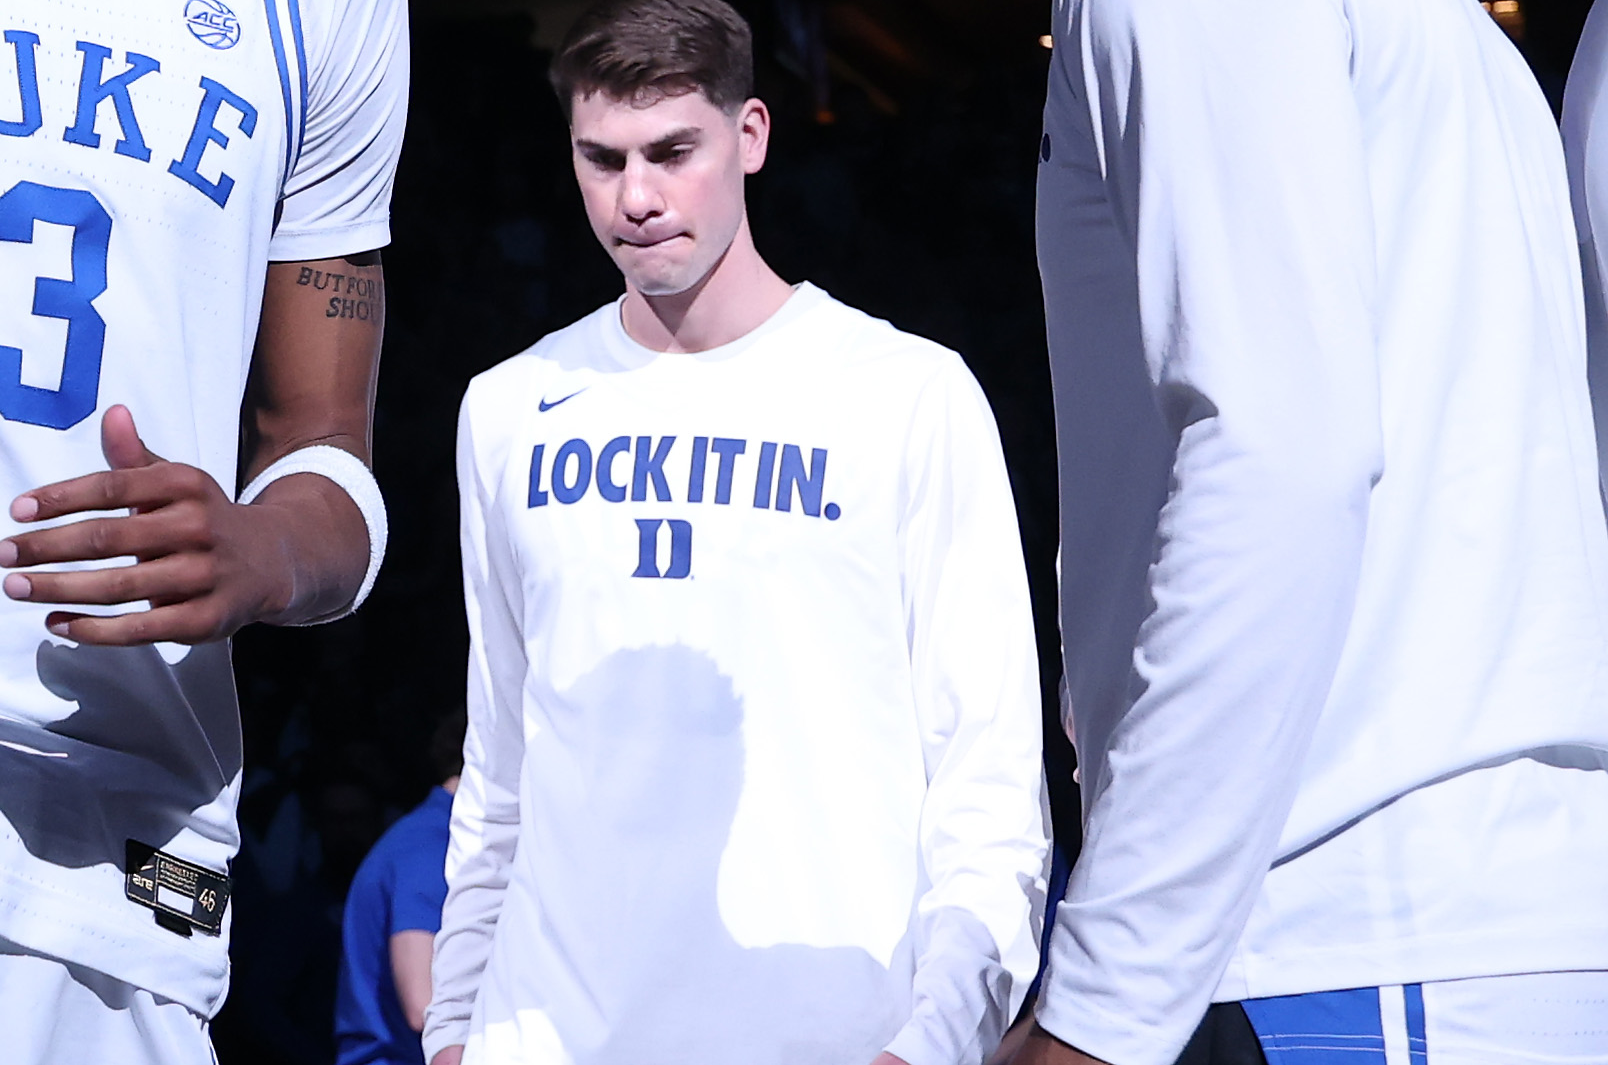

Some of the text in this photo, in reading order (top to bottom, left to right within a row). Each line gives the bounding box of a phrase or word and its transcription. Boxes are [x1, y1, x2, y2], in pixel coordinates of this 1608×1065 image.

[193, 11, 238, 30] ACC
[297, 266, 345, 292] BUT
[527, 435, 841, 521] LOCK IT IN.
[198, 888, 217, 913] 46
